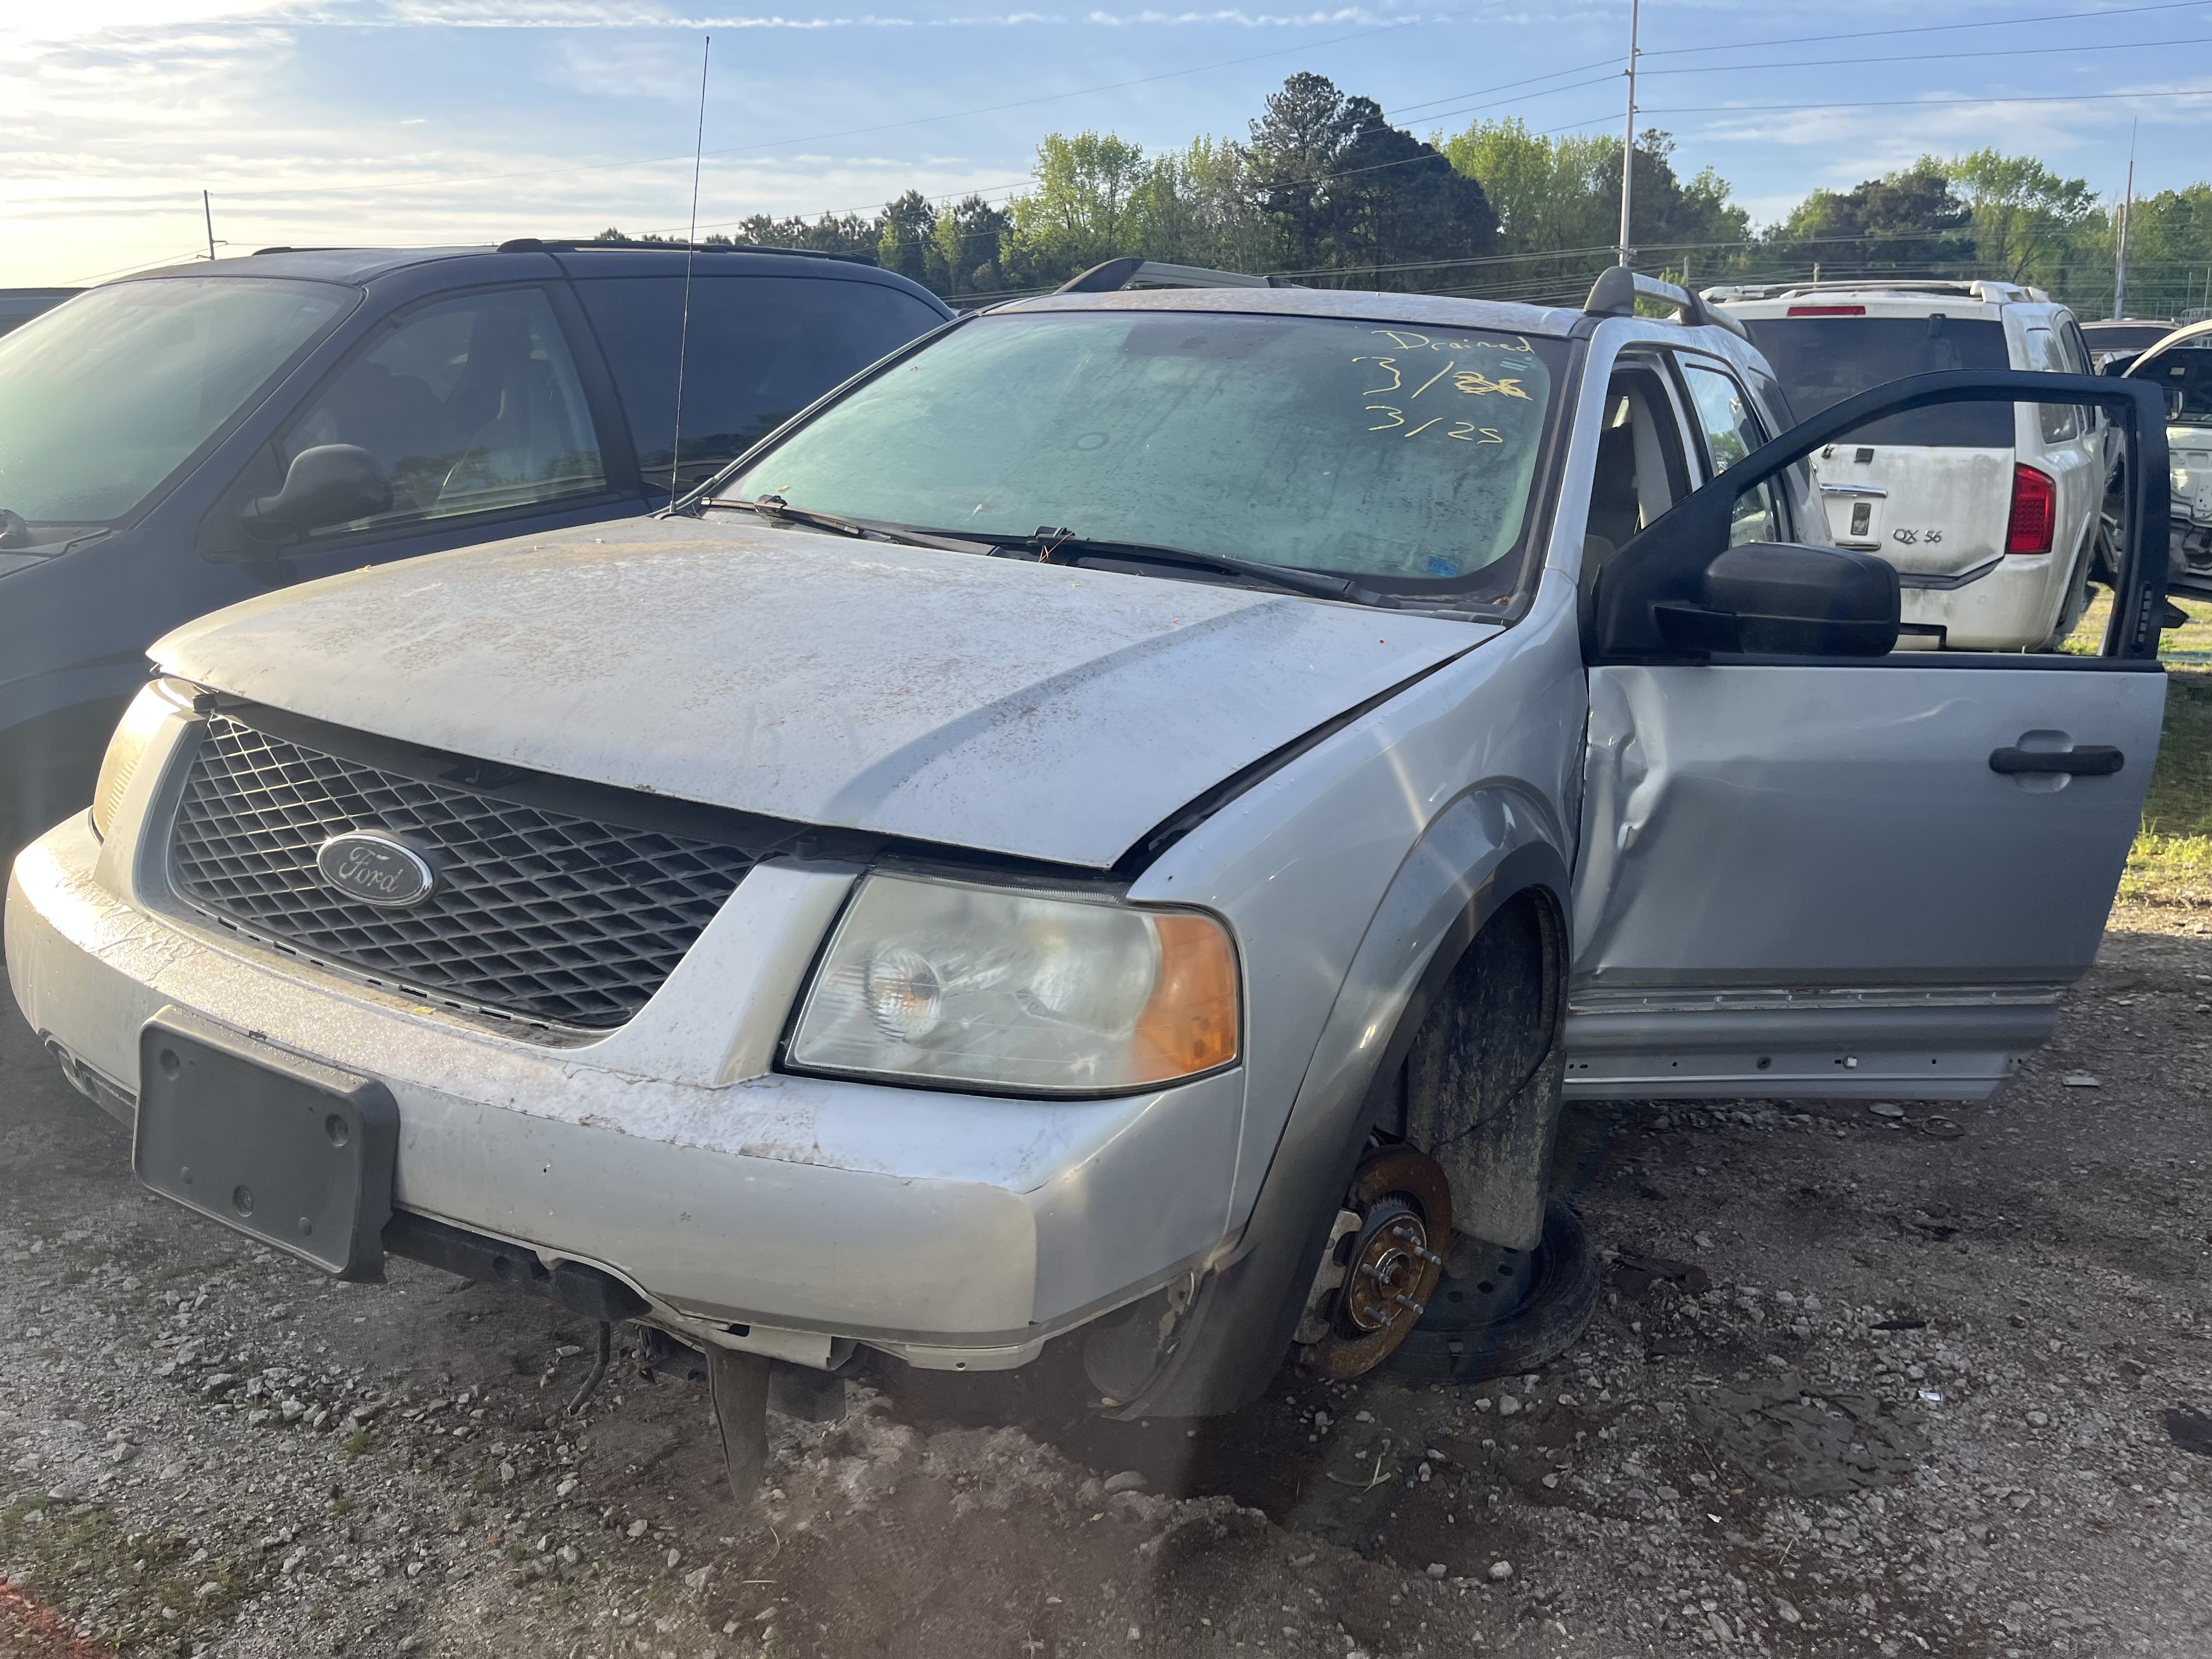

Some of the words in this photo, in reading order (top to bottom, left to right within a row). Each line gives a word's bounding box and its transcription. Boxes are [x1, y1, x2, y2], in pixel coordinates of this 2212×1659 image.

[1371, 330, 1536, 355] Drained
[1893, 529, 1919, 545] QX
[1924, 529, 1942, 543] 56
[338, 847, 404, 893] Ford
